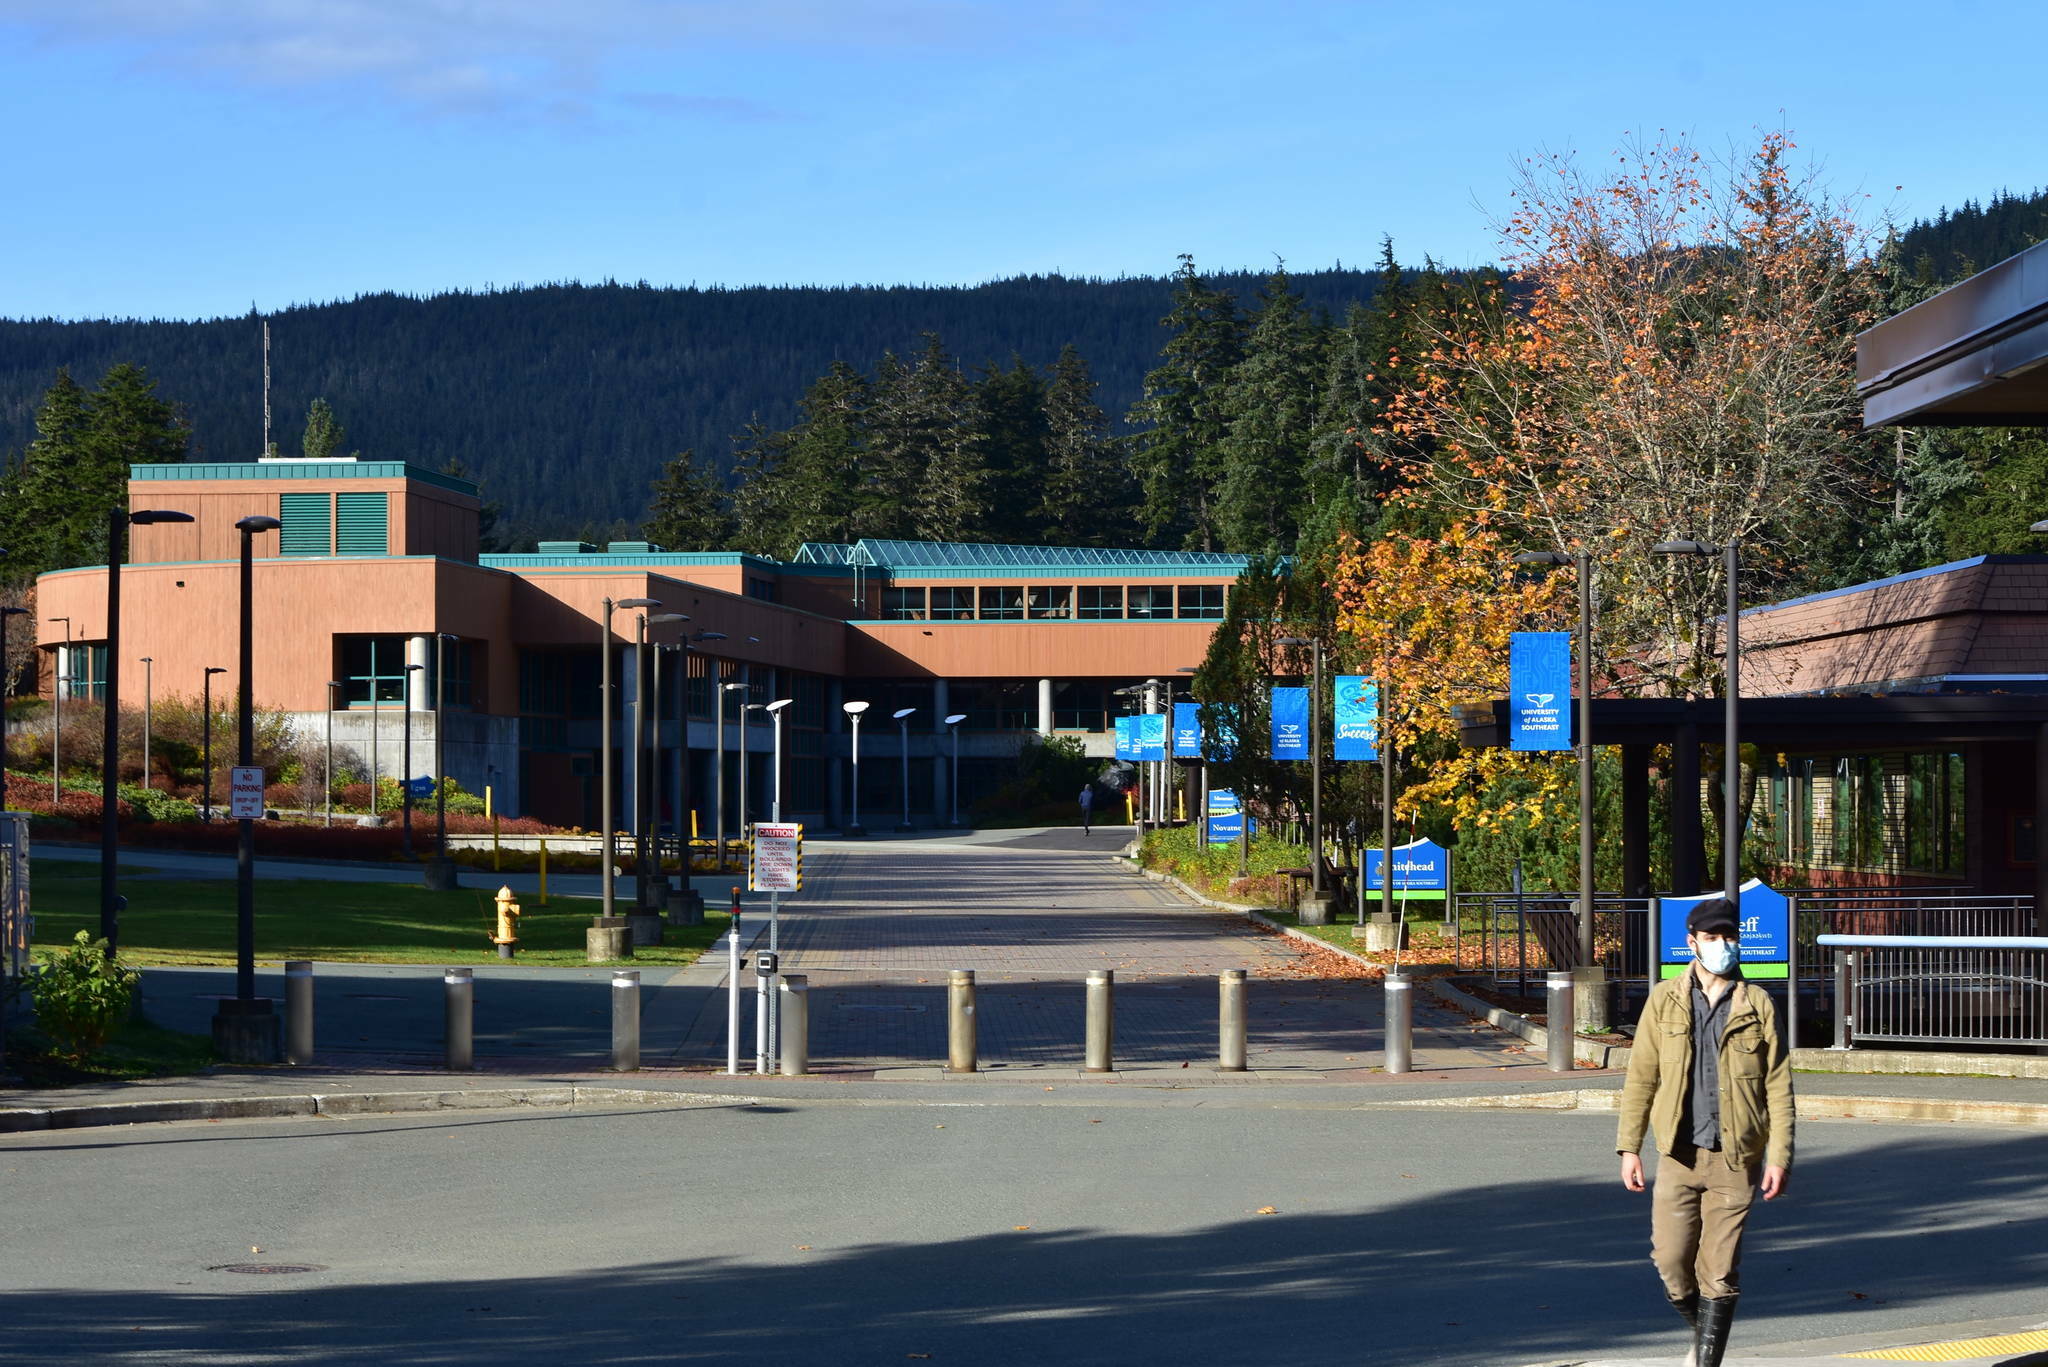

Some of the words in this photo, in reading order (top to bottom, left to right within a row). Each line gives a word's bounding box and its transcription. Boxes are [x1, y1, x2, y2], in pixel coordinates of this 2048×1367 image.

[1337, 724, 1378, 740] Success
[243, 773, 252, 781] NO
[233, 784, 262, 792] PARKING
[1212, 823, 1242, 831] Novatne
